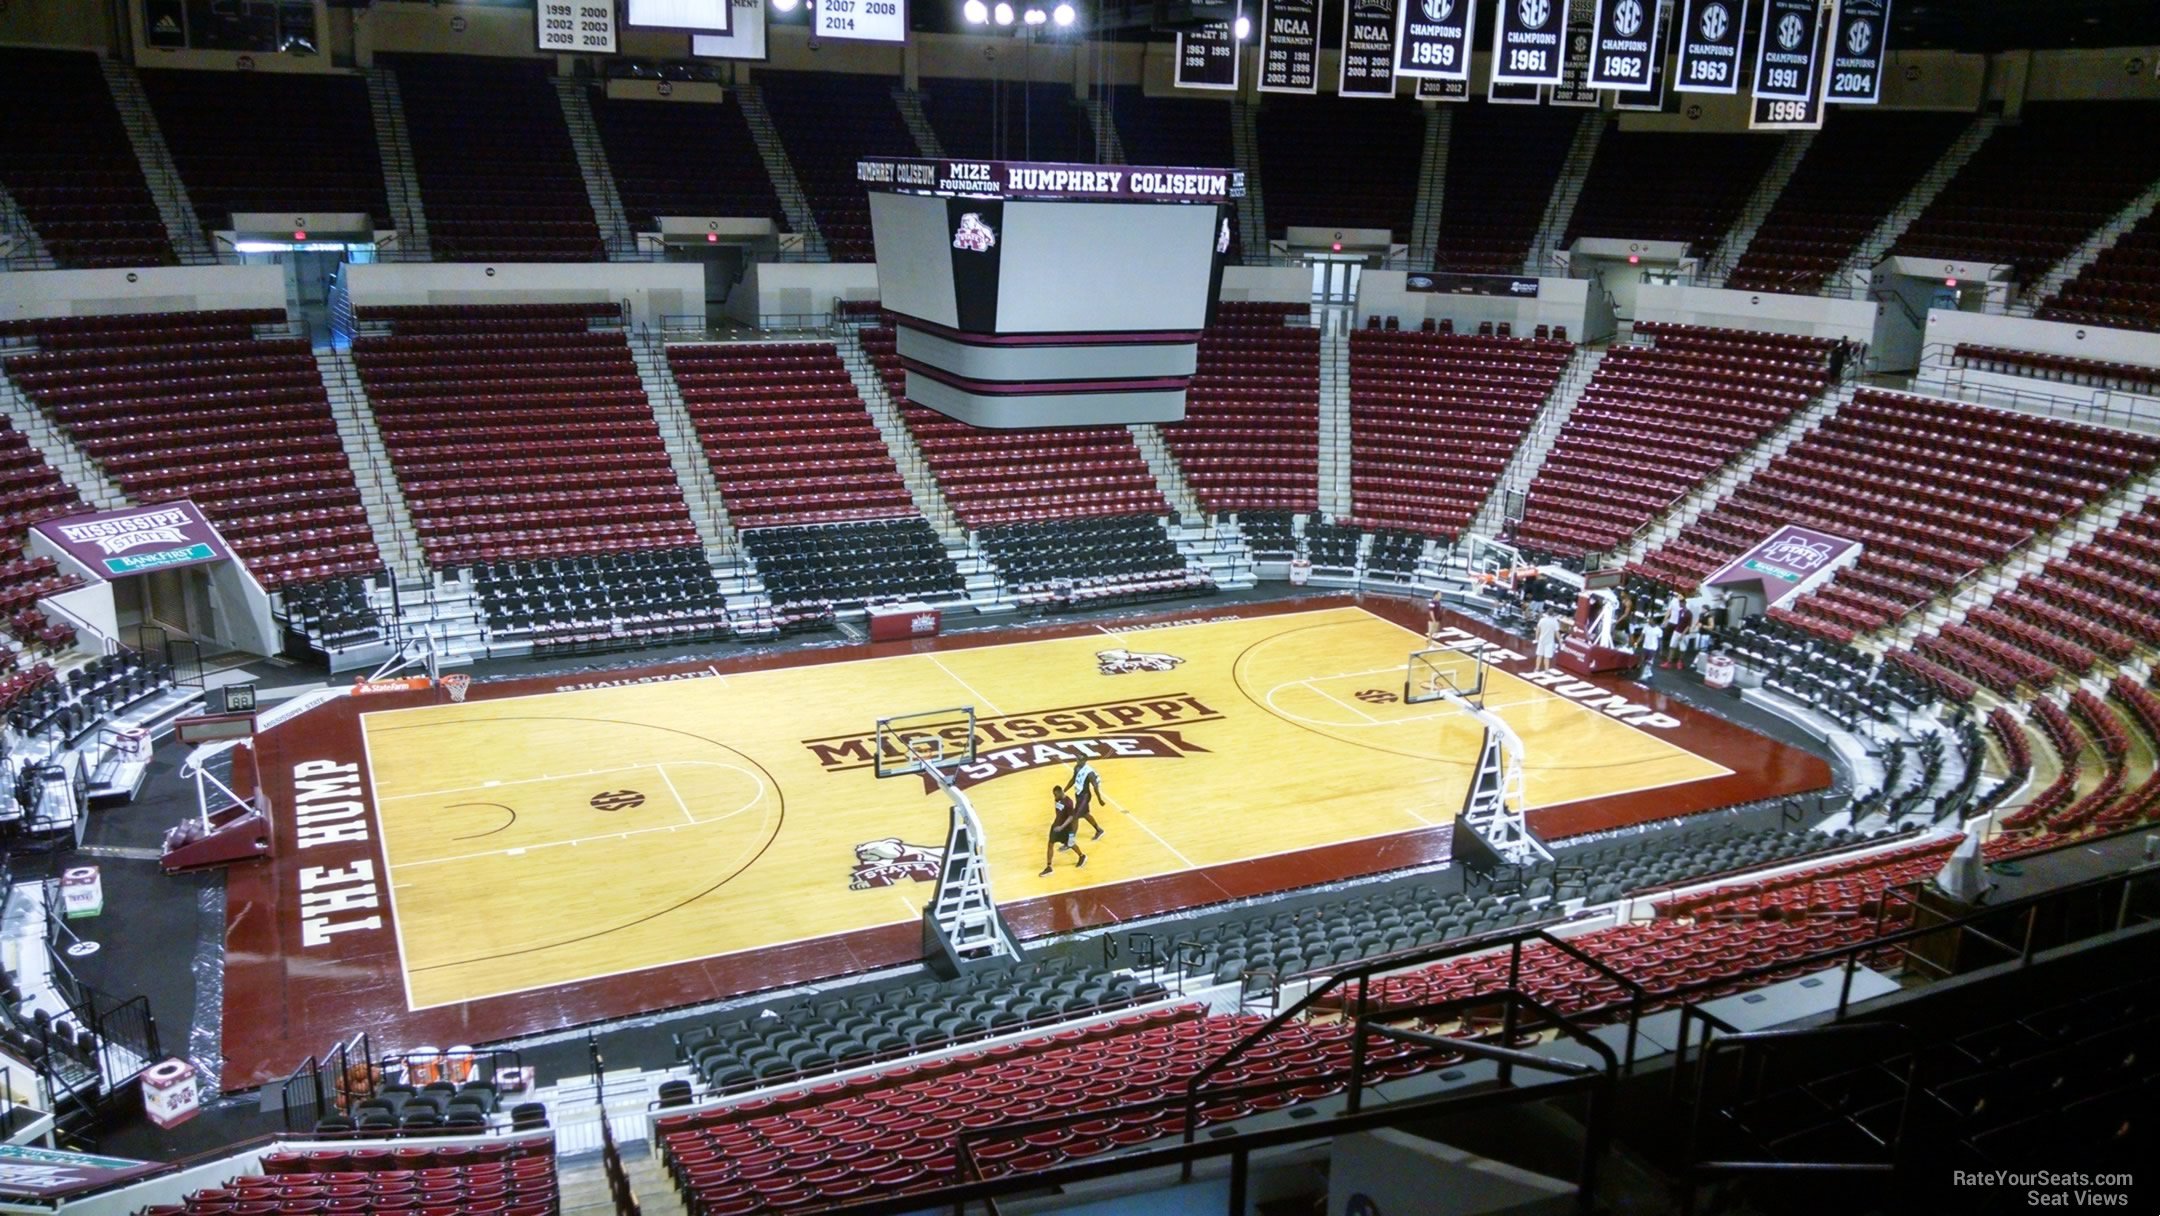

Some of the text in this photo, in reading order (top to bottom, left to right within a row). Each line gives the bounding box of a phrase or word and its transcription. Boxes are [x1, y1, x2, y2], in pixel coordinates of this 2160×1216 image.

[547, 5, 608, 18] 1999 2000
[826, 0, 896, 15] 2007 2008
[1520, 0, 1550, 28] SEC
[547, 19, 608, 32] 2002 2003
[826, 17, 855, 30] 2014
[1615, 0, 1641, 34] SEC
[1702, 4, 1728, 39] SEC
[1273, 18, 1310, 35] NCAA
[1354, 25, 1388, 41] NCAA
[1410, 24, 1462, 38] CHAMPIONS
[1778, 14, 1802, 48] SEC
[547, 33, 608, 46] 2009 2010
[1269, 35, 1313, 45] TOURNAMENT
[1507, 32, 1557, 45] CHAMPIONS
[1848, 19, 1871, 54] SEC
[1349, 41, 1392, 51] TOURNAMENT
[1411, 41, 1455, 66] 1959
[1602, 40, 1647, 52] CHAMPIONS
[1688, 43, 1734, 56] CHAMPIONS
[1509, 49, 1547, 71] 1961
[1603, 56, 1641, 77] 1962
[1766, 52, 1808, 64] CHAMPIONS
[1835, 58, 1876, 69] CHAMPIONS
[1267, 74, 1310, 85] 2002 2003
[1690, 60, 1727, 81] 1963
[1767, 68, 1798, 88] 1991
[1834, 74, 1870, 92] 2004
[1767, 102, 1806, 120] 1996
[856, 161, 935, 186] HUMPHREY COLISEUM
[950, 163, 990, 180] MIZE
[940, 179, 1000, 192] FOUNDATION
[1008, 168, 1226, 195] HUMPHREY COLISEUM
[62, 510, 191, 541] MISSISSIPPI
[113, 532, 173, 549] STATE
[1779, 546, 1818, 561] STATE
[1432, 626, 1528, 665] THE
[1518, 668, 1682, 729] HUMP
[263, 696, 325, 729] MISSISSIPPI STATE
[807, 696, 1219, 766] MISSISSIPPI
[960, 737, 1156, 780] STATE
[294, 760, 369, 848] HUMP
[590, 790, 646, 811] SEC
[864, 863, 929, 879] STATE
[299, 859, 382, 947] THE
